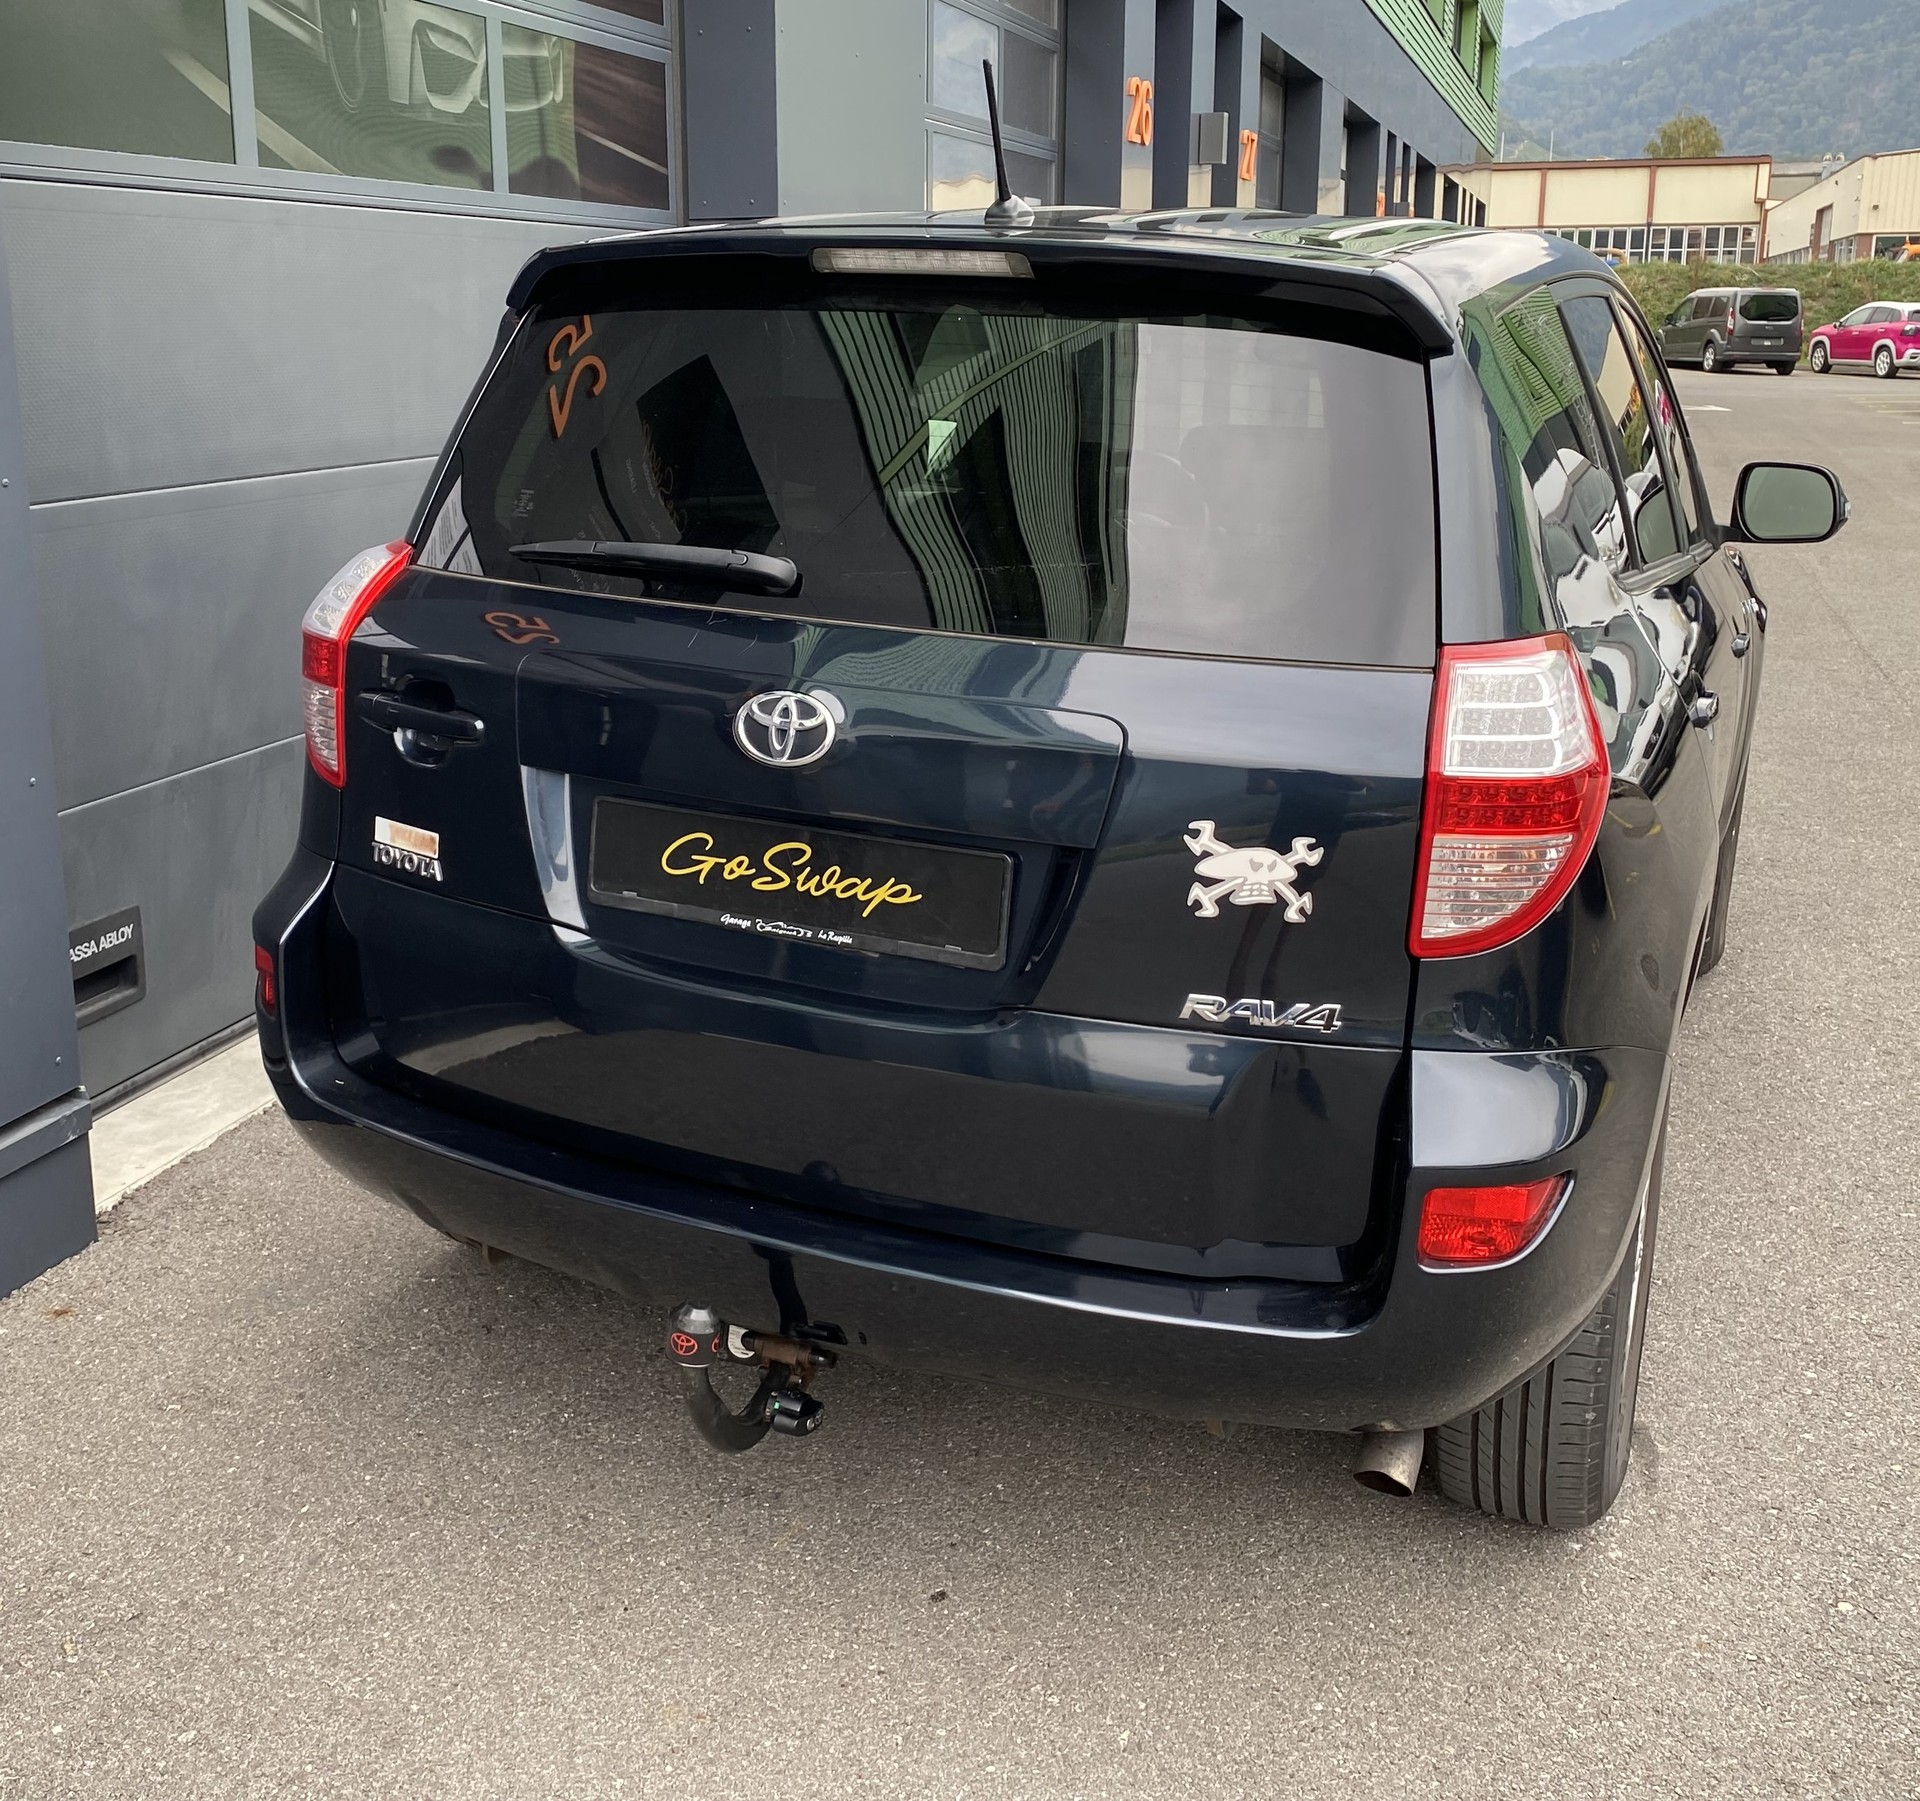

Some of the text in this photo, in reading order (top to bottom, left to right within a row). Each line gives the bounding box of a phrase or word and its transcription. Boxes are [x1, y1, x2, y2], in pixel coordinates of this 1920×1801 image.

[1126, 76, 1153, 146] 26
[1239, 129, 1258, 181] 27
[371, 841, 443, 882] TOYOTA
[661, 832, 922, 918] GoSwap
[720, 913, 752, 929] Garage
[69, 923, 134, 962] ASSA ABLOY
[1179, 993, 1343, 1034] RAV4
